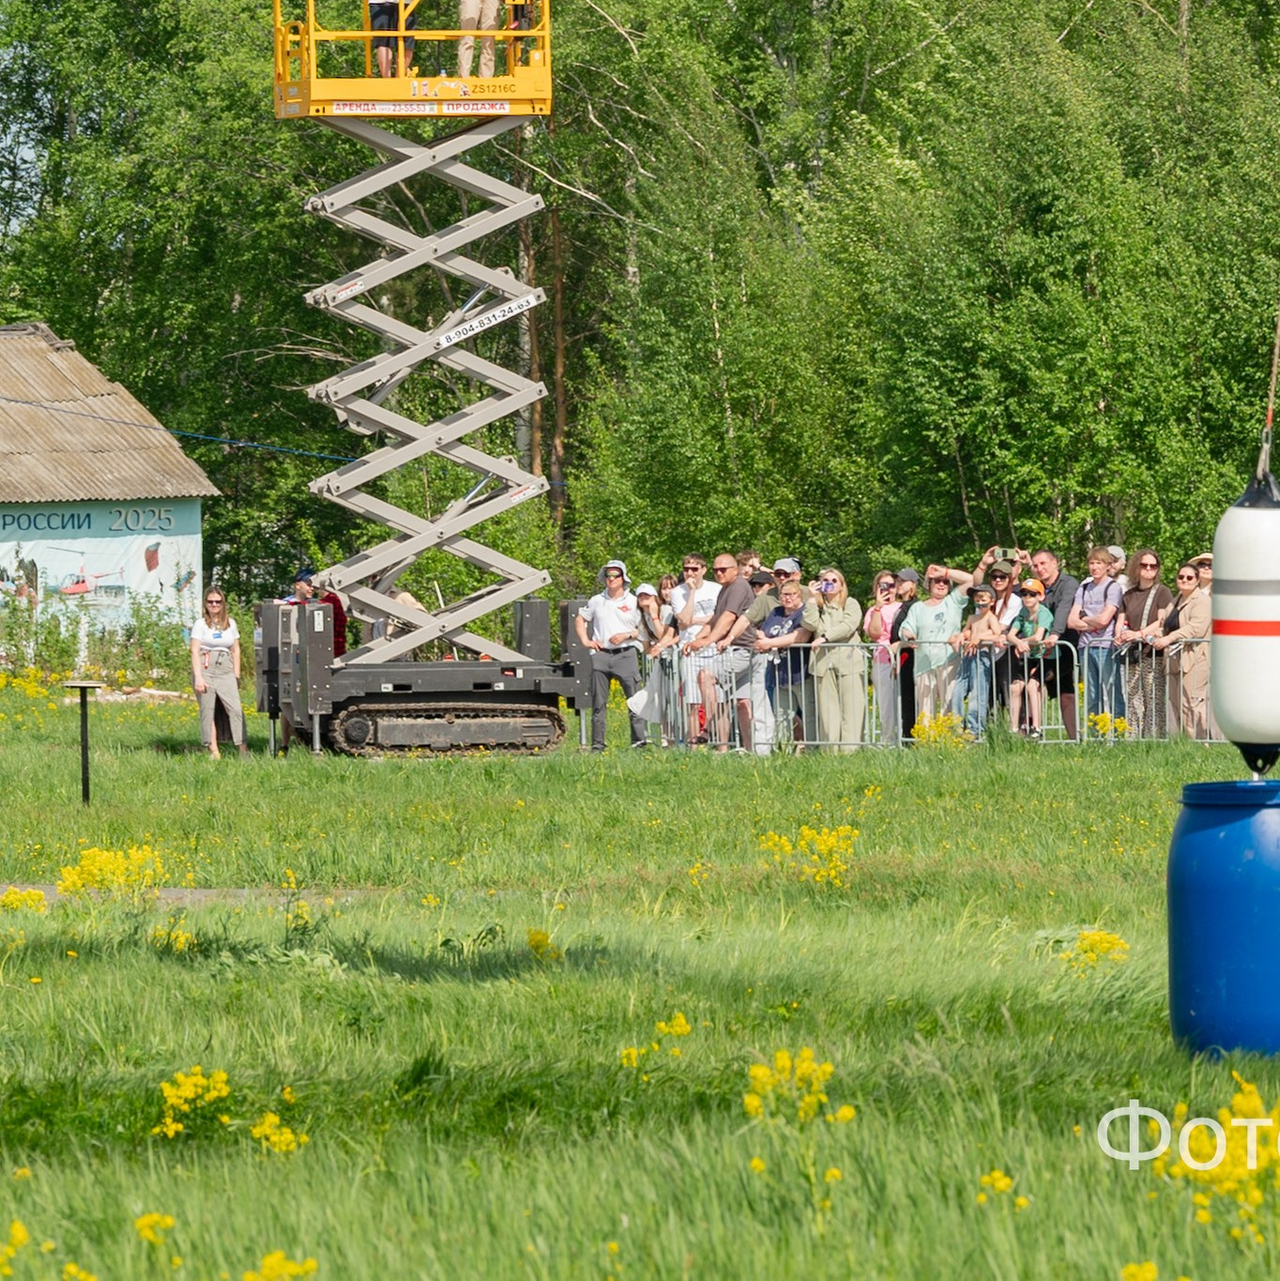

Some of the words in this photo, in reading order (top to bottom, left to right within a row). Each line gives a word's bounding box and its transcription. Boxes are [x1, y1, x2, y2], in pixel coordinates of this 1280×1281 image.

[471, 84, 517, 94] ZS1216C
[335, 102, 377, 113] АРЕНДА
[446, 102, 506, 112] ПРОДАЖА
[2, 512, 92, 531] РОССИИ
[108, 507, 176, 532] 2025
